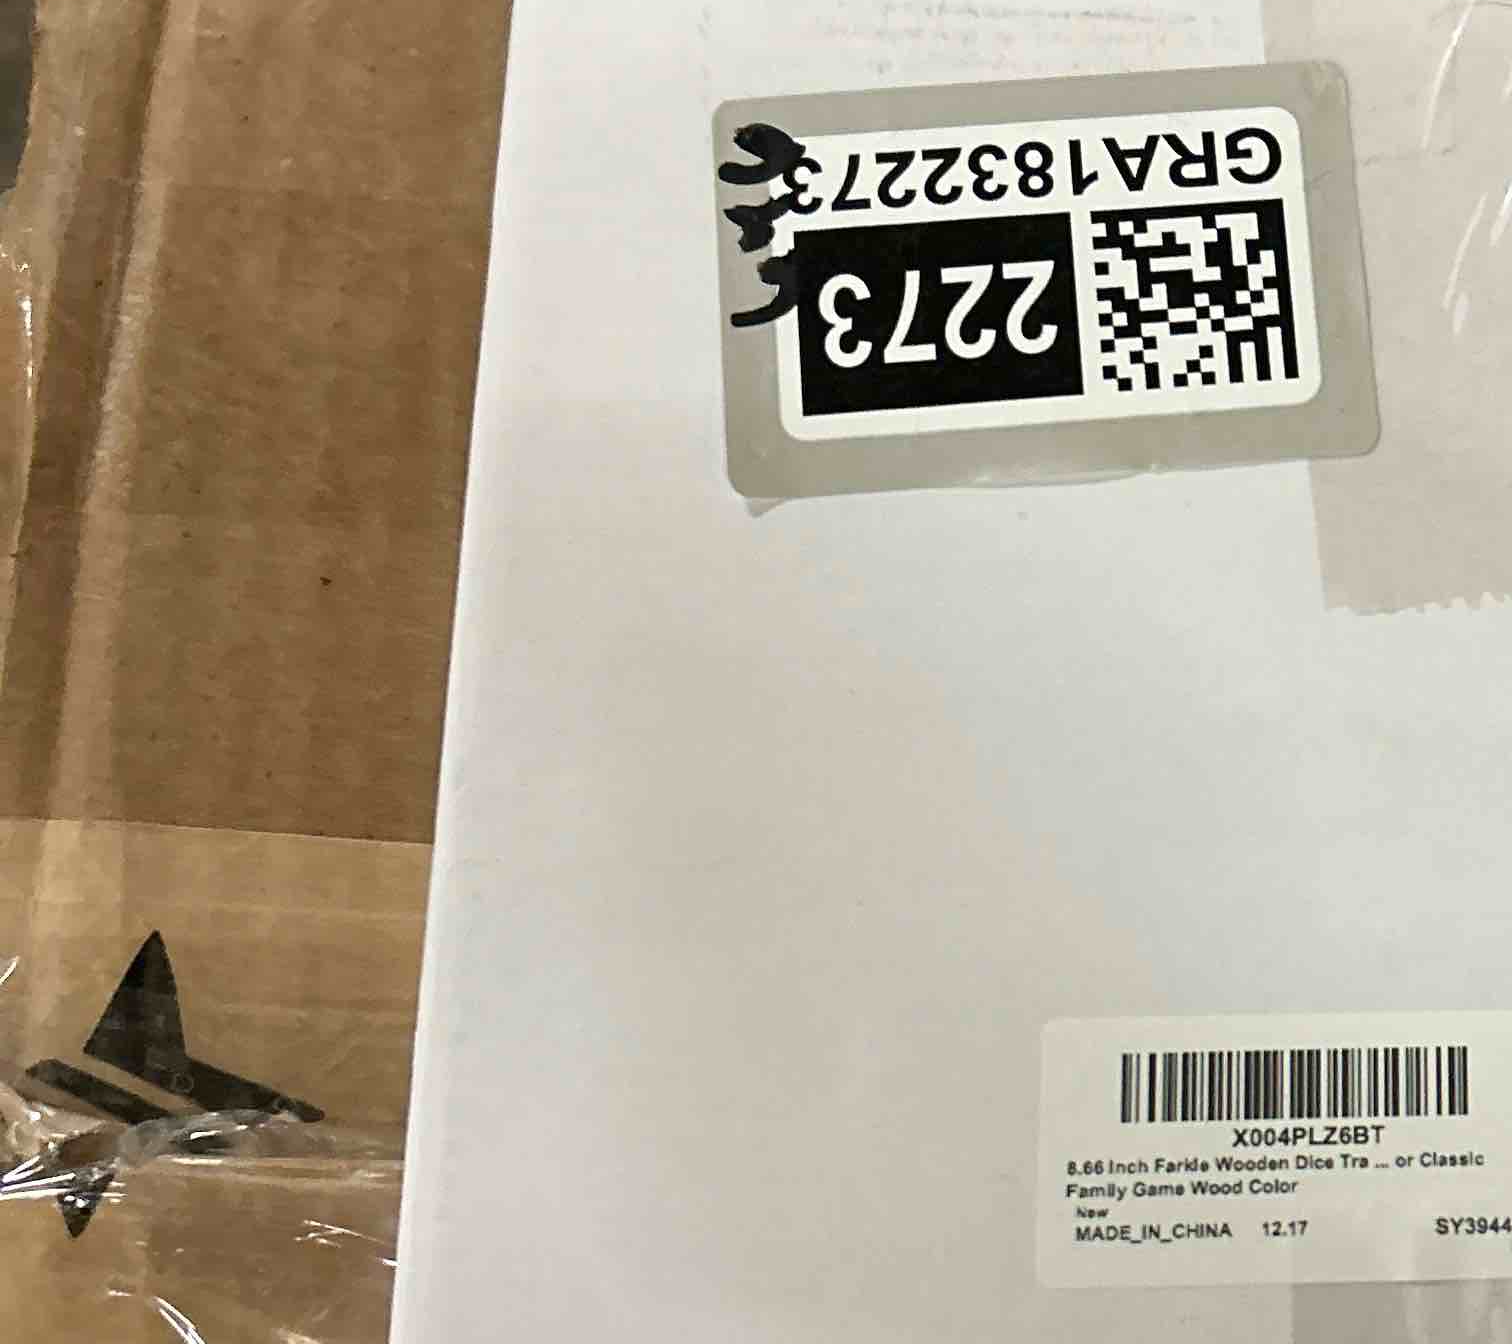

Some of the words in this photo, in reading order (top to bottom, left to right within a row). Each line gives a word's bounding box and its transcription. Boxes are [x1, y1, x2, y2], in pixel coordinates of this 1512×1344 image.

[785, 126, 1282, 216] GRA1832273
[817, 259, 1059, 369] 2273
[1232, 1125, 1385, 1148] X004PLZ6BT
[1067, 1160, 1104, 1175] 8.66
[1109, 1159, 1149, 1174] Inch
[1154, 1157, 1209, 1173] Farkle
[1216, 1156, 1289, 1172] Wooden
[1295, 1154, 1334, 1170] Dice
[1340, 1153, 1369, 1169] Tra
[1395, 1155, 1414, 1168] or
[1420, 1151, 1485, 1167] Classic
[1066, 1183, 1127, 1200] Family
[1133, 1181, 1185, 1197] Game
[1191, 1179, 1243, 1195] Wood
[1249, 1178, 1298, 1194] Color
[1076, 1206, 1109, 1218] New
[1075, 1223, 1233, 1244] MADE_IN_CHINA
[1263, 1220, 1308, 1237] 12.17
[1435, 1216, 1512, 1235] SY3944
